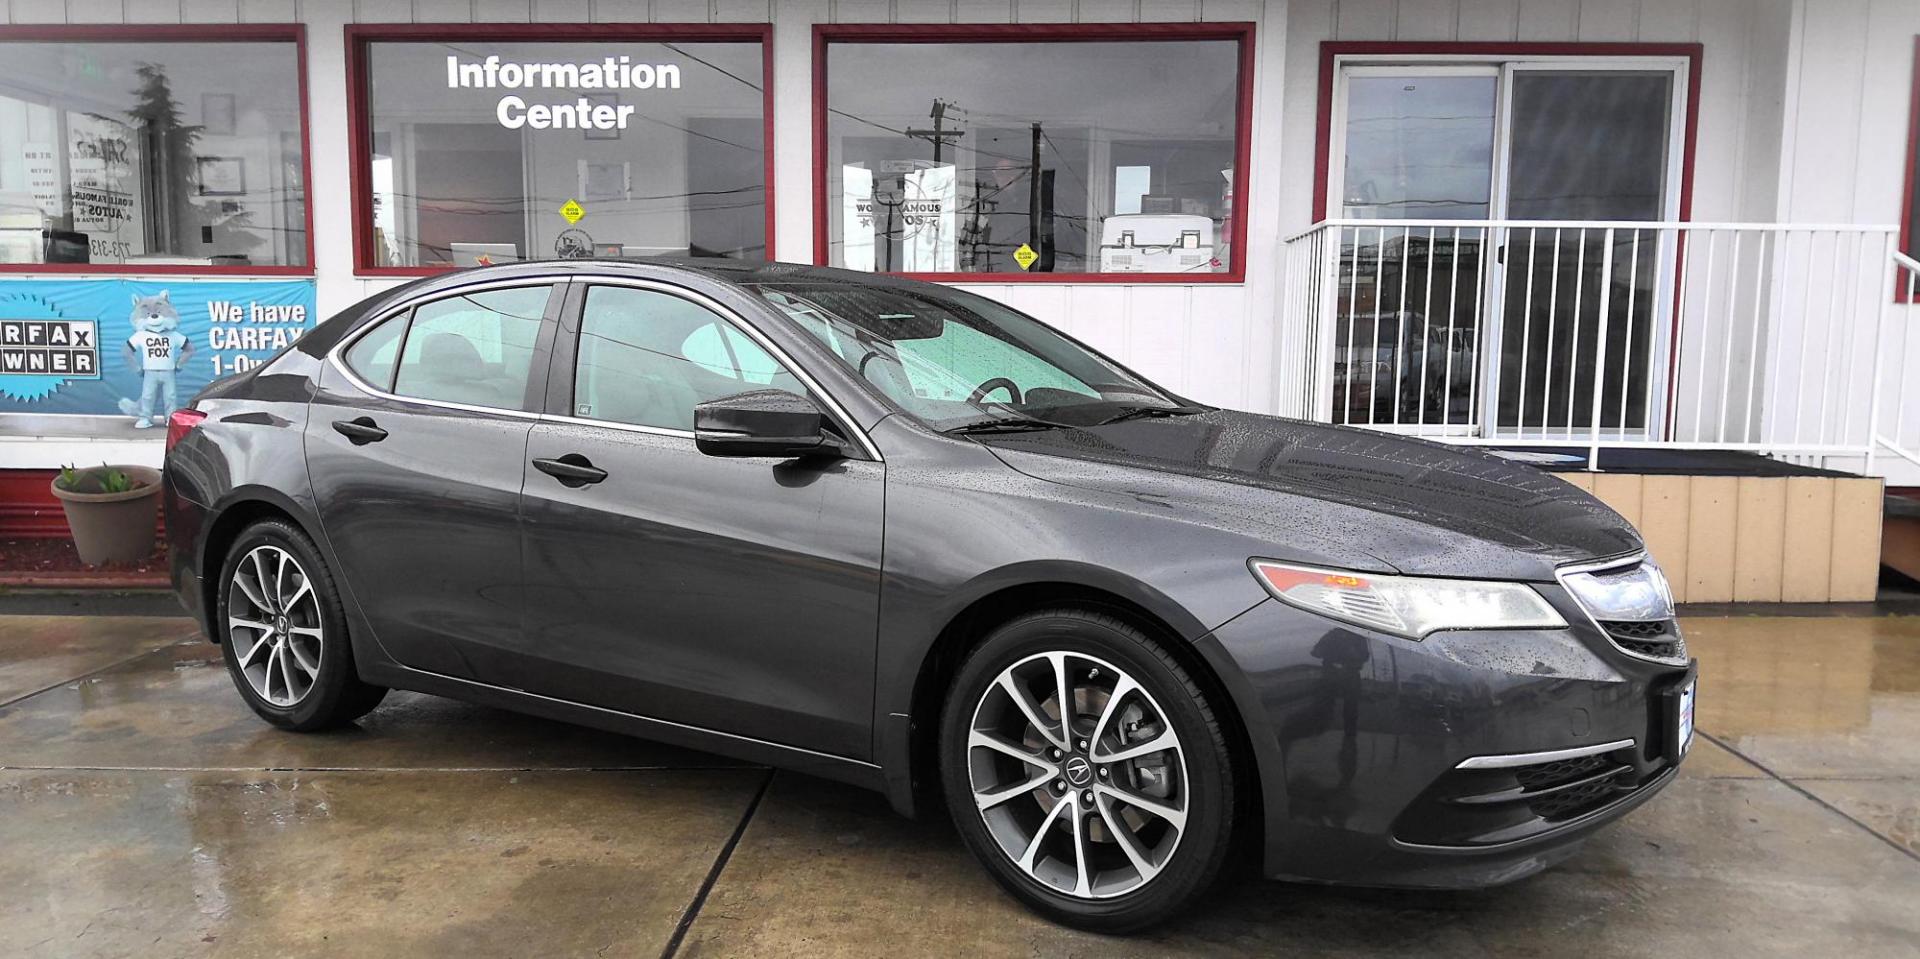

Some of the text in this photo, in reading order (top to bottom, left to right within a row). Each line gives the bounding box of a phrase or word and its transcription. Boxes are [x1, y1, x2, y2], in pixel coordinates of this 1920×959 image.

[447, 55, 681, 90] Information
[496, 95, 635, 130] Center
[902, 203, 942, 213] AMOUS
[208, 300, 306, 323] We have
[4, 324, 90, 347] RFAX
[145, 337, 170, 347] CAR
[208, 326, 305, 351] CARFAX
[3, 352, 91, 371] WNER
[148, 347, 169, 358] FOX
